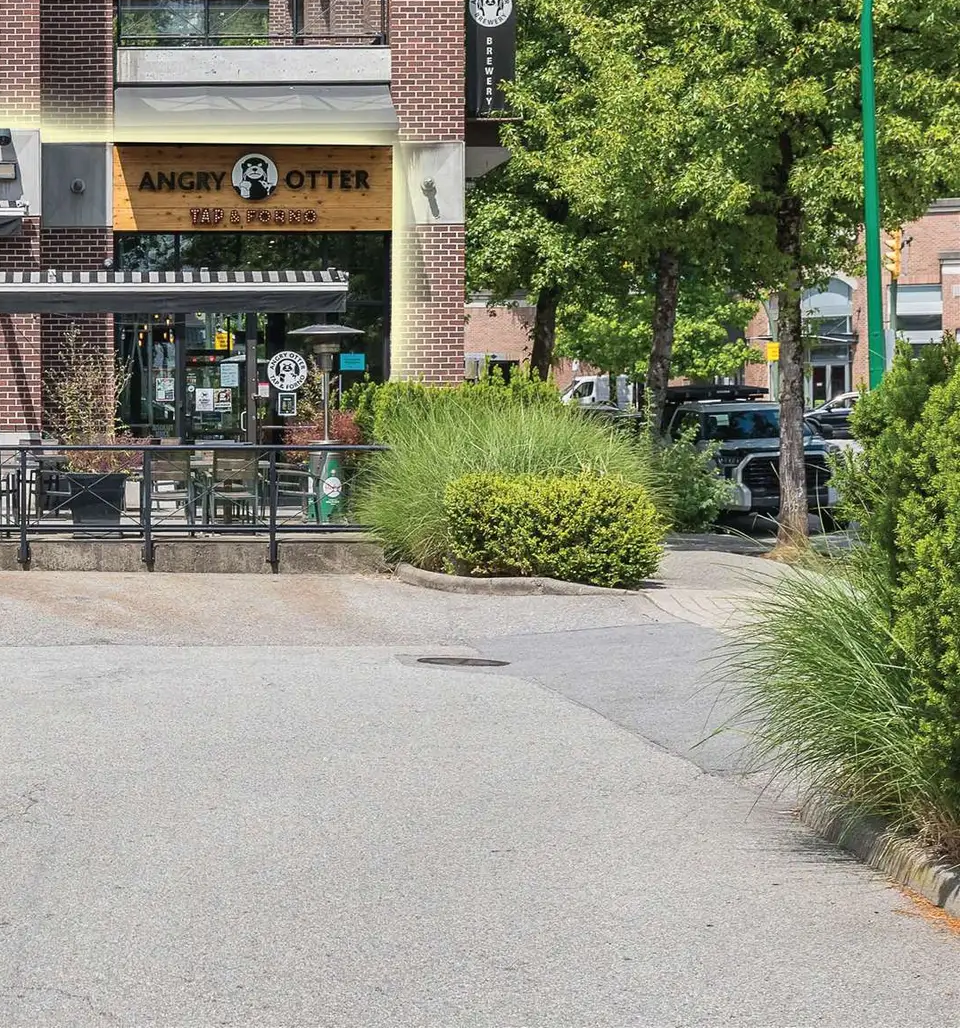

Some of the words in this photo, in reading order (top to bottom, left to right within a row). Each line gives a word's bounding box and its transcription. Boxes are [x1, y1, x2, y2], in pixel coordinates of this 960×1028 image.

[474, 12, 508, 25] BREWERY
[484, 37, 494, 105] BREWERY
[139, 171, 226, 191] ANGRY
[285, 169, 371, 190] OTTER
[190, 208, 225, 225] TAP
[230, 209, 241, 224] &
[246, 209, 318, 224] FORNO
[269, 352, 288, 370] ANGRY
[289, 352, 306, 370] OTTER
[269, 375, 280, 386] TAP
